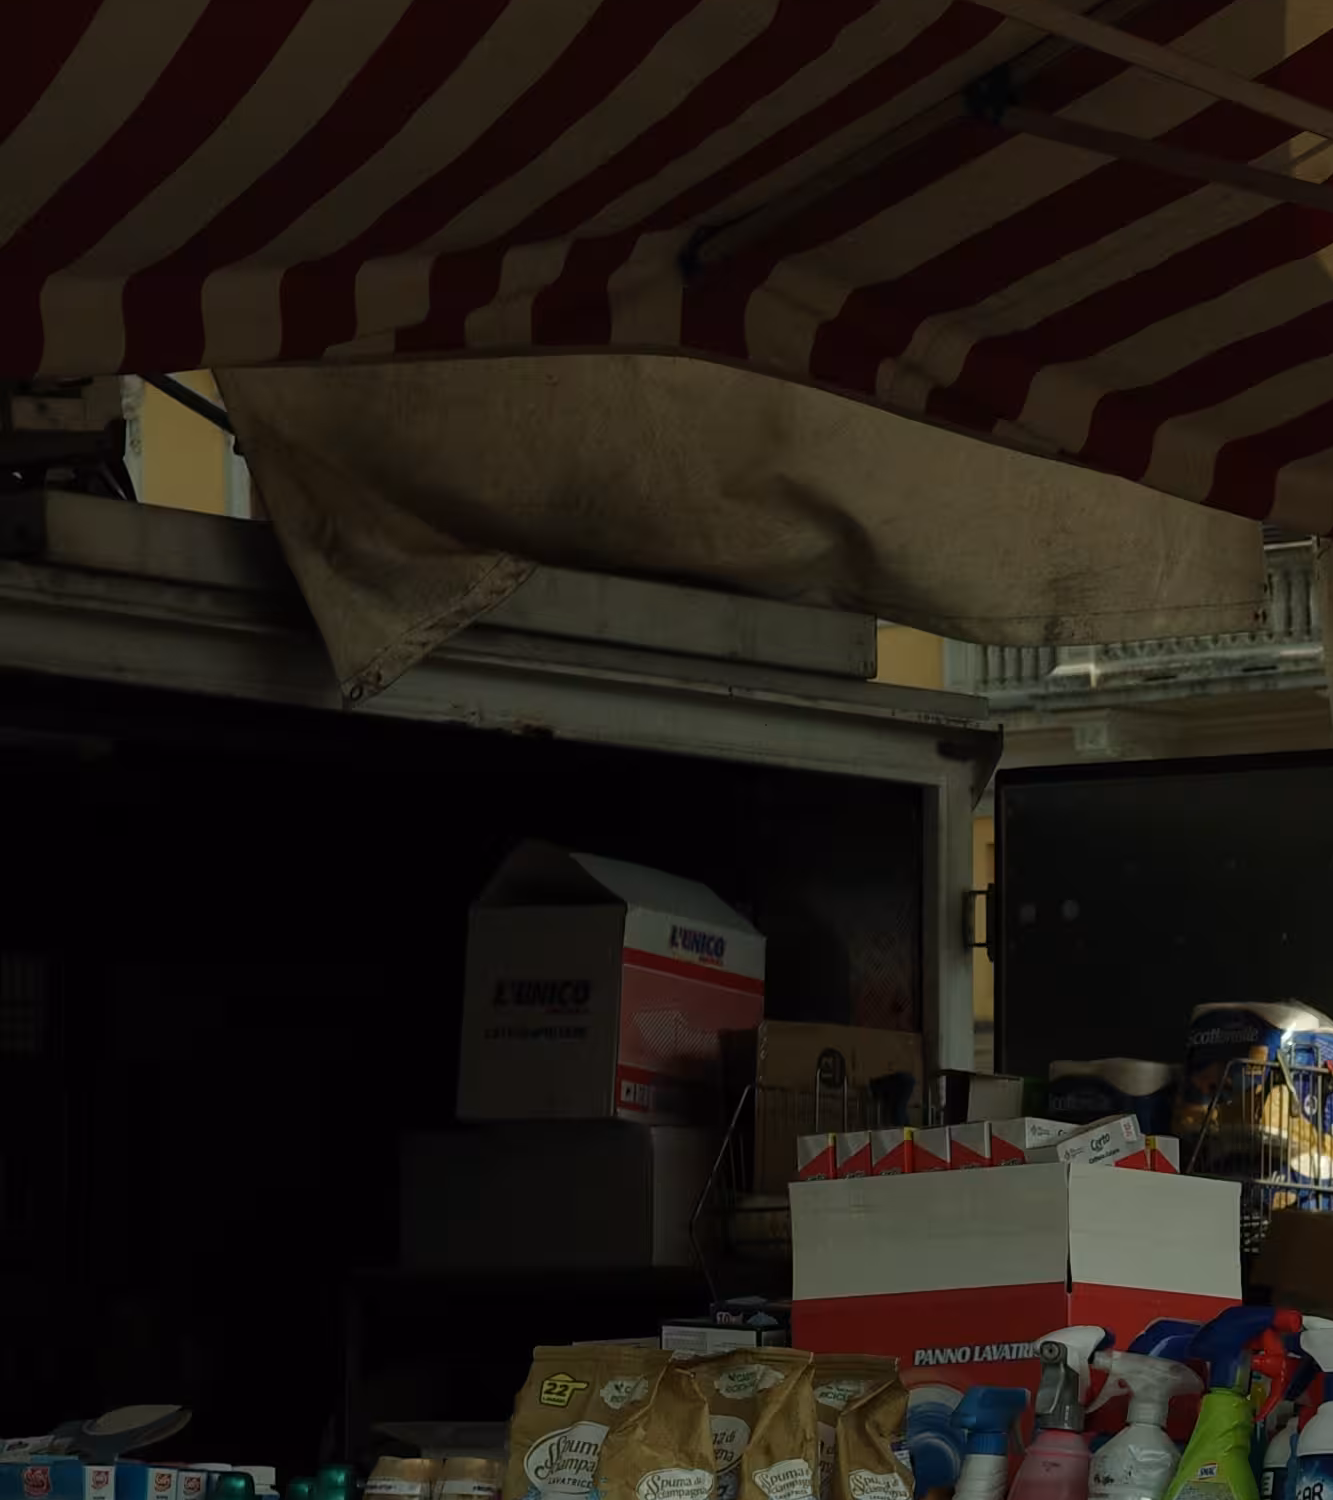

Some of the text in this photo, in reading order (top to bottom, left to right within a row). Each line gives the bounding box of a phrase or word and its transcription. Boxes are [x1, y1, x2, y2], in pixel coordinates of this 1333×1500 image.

[670, 924, 725, 958] L'UNICO
[912, 1347, 969, 1367] PANNO
[543, 1381, 570, 1399] 22
